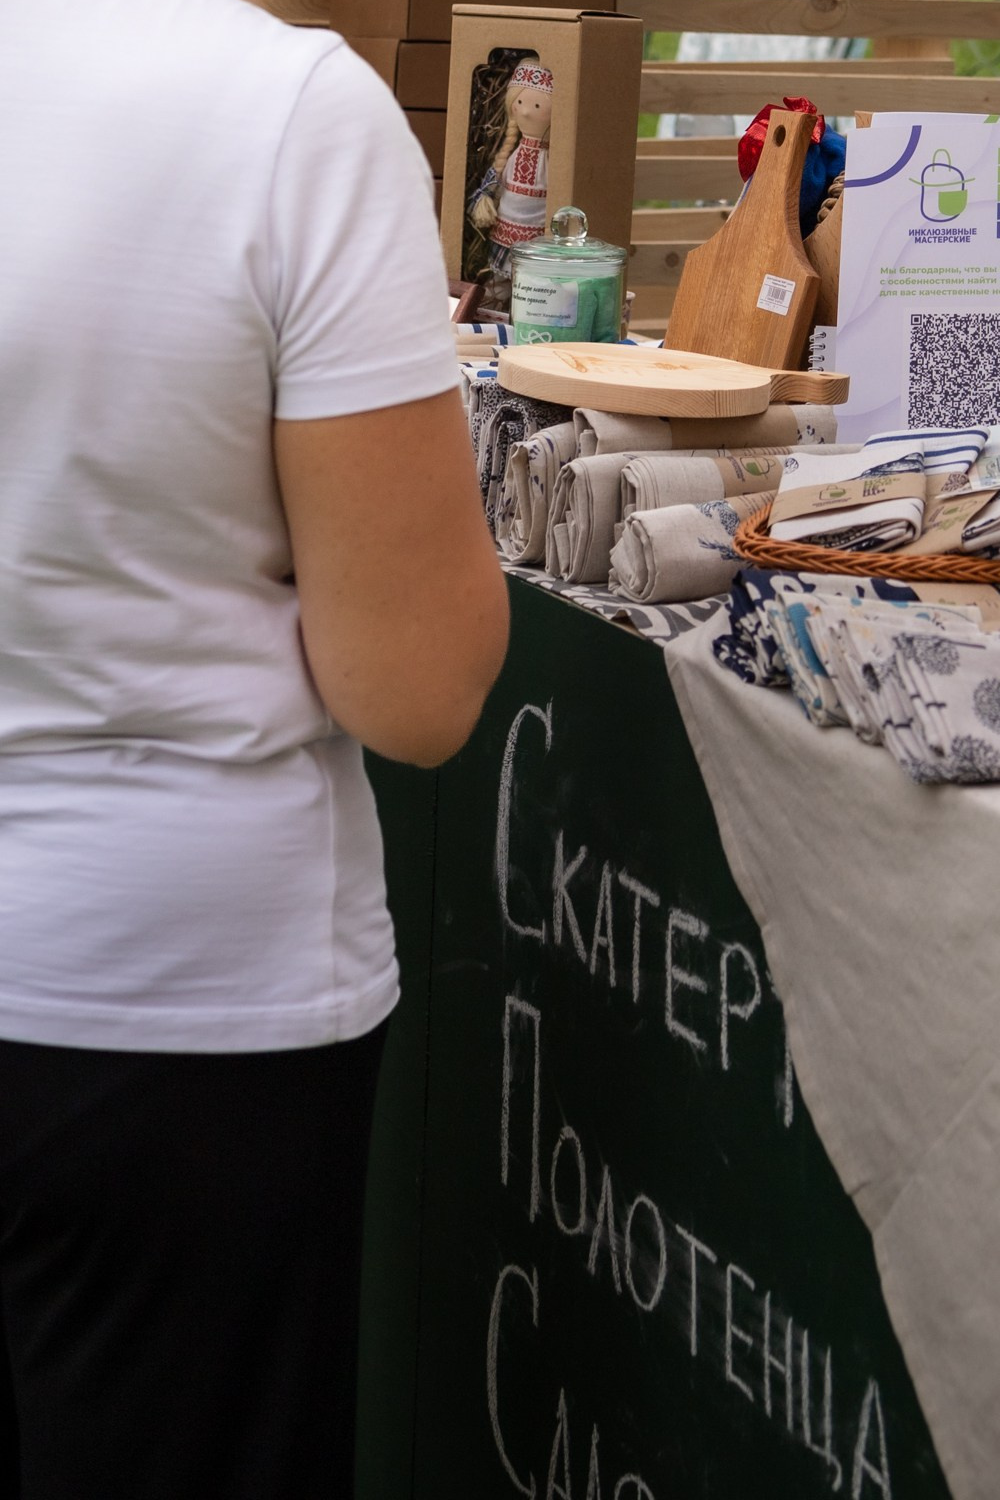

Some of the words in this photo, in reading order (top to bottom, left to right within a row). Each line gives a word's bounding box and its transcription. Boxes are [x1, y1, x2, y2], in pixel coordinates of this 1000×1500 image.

[908, 228, 977, 236] ИНКЛЮЗИВНЫЕ
[914, 236, 971, 244] МАСТЕРСКИЕ
[899, 266, 962, 275] благодарны,
[887, 277, 965, 285] особенностями
[967, 276, 997, 284] найти
[879, 289, 898, 297] для
[919, 288, 990, 297] качественные
